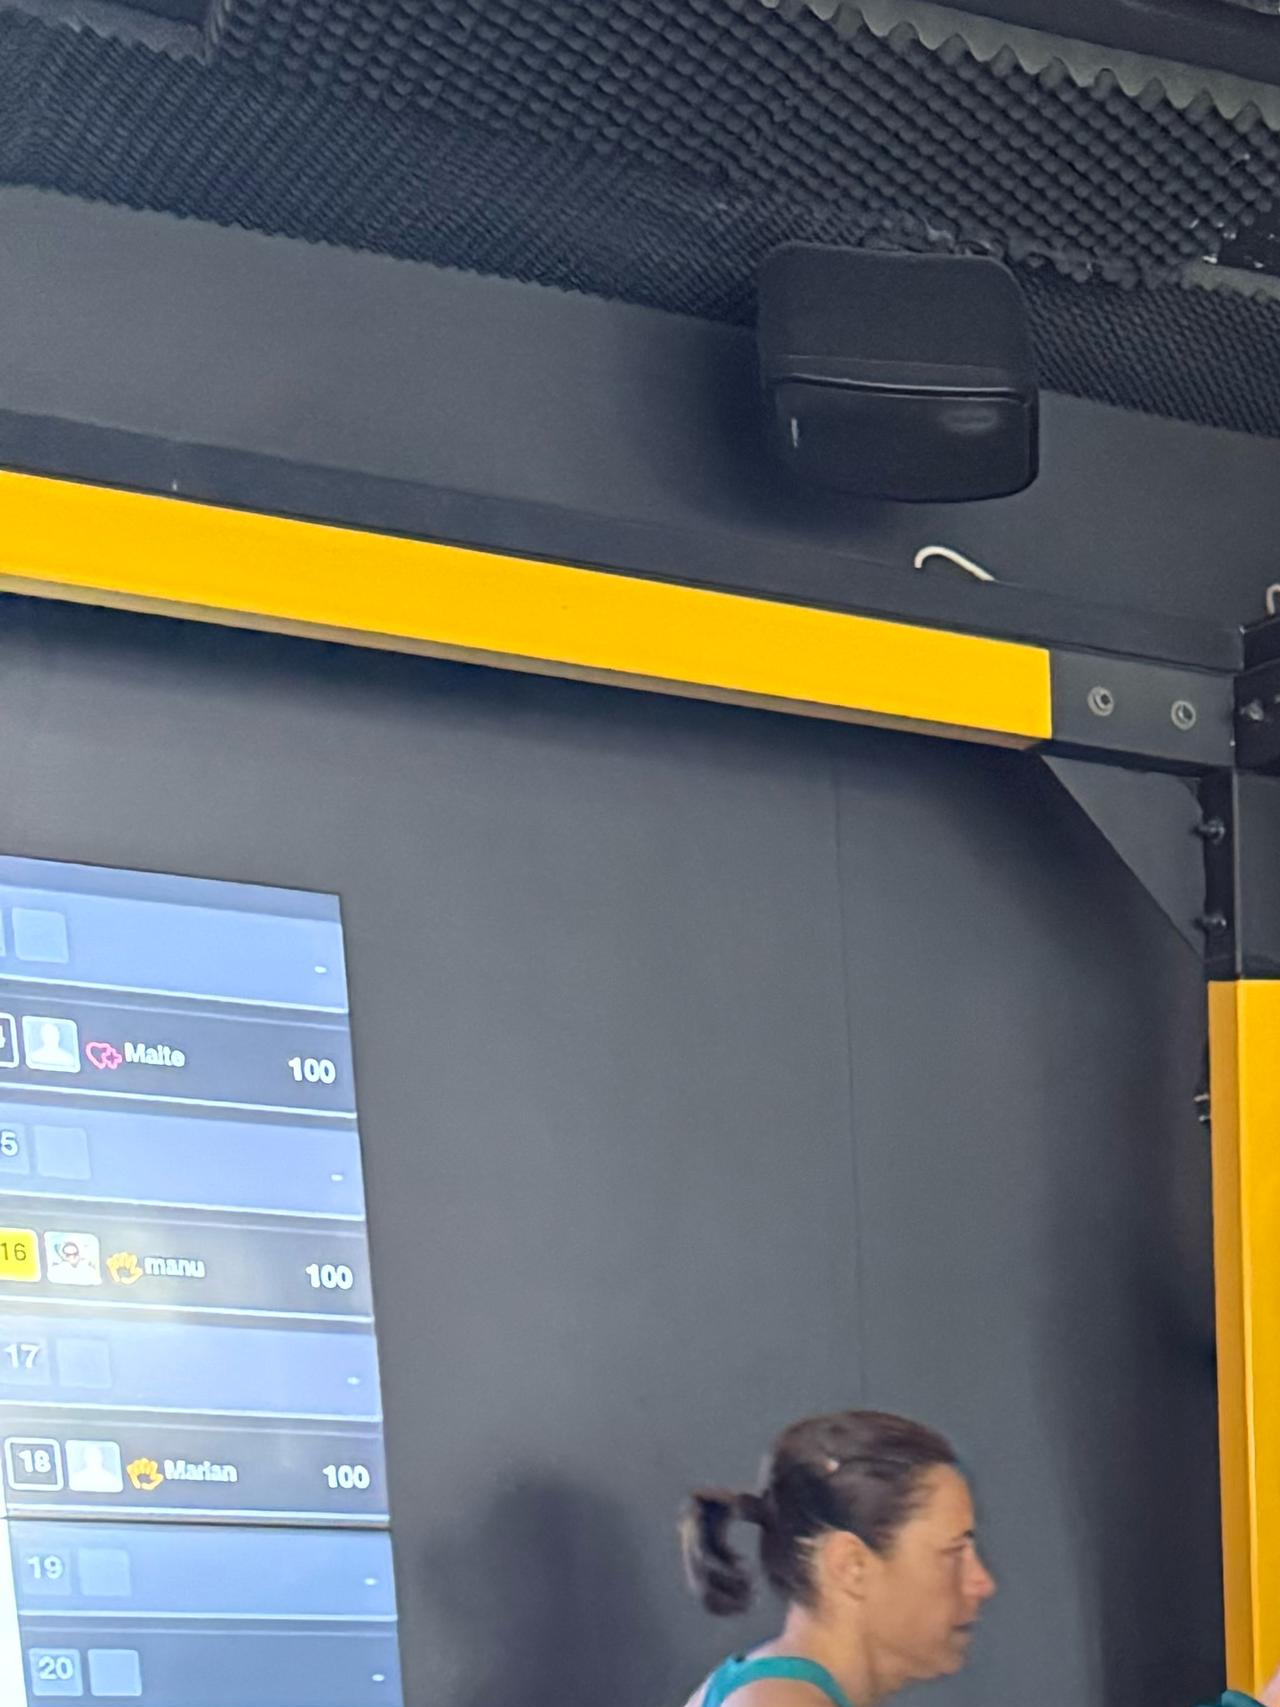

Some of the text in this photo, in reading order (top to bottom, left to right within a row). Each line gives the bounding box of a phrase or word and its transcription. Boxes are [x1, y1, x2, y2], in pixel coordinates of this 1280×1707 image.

[288, 1057, 337, 1085] 100
[0, 1131, 19, 1157] 5
[0, 1242, 354, 1290] 16 manu 100
[6, 1343, 40, 1370] 17
[17, 1449, 371, 1491] 18 Marian 100
[27, 1555, 64, 1580] 19
[38, 1655, 74, 1681] 20
